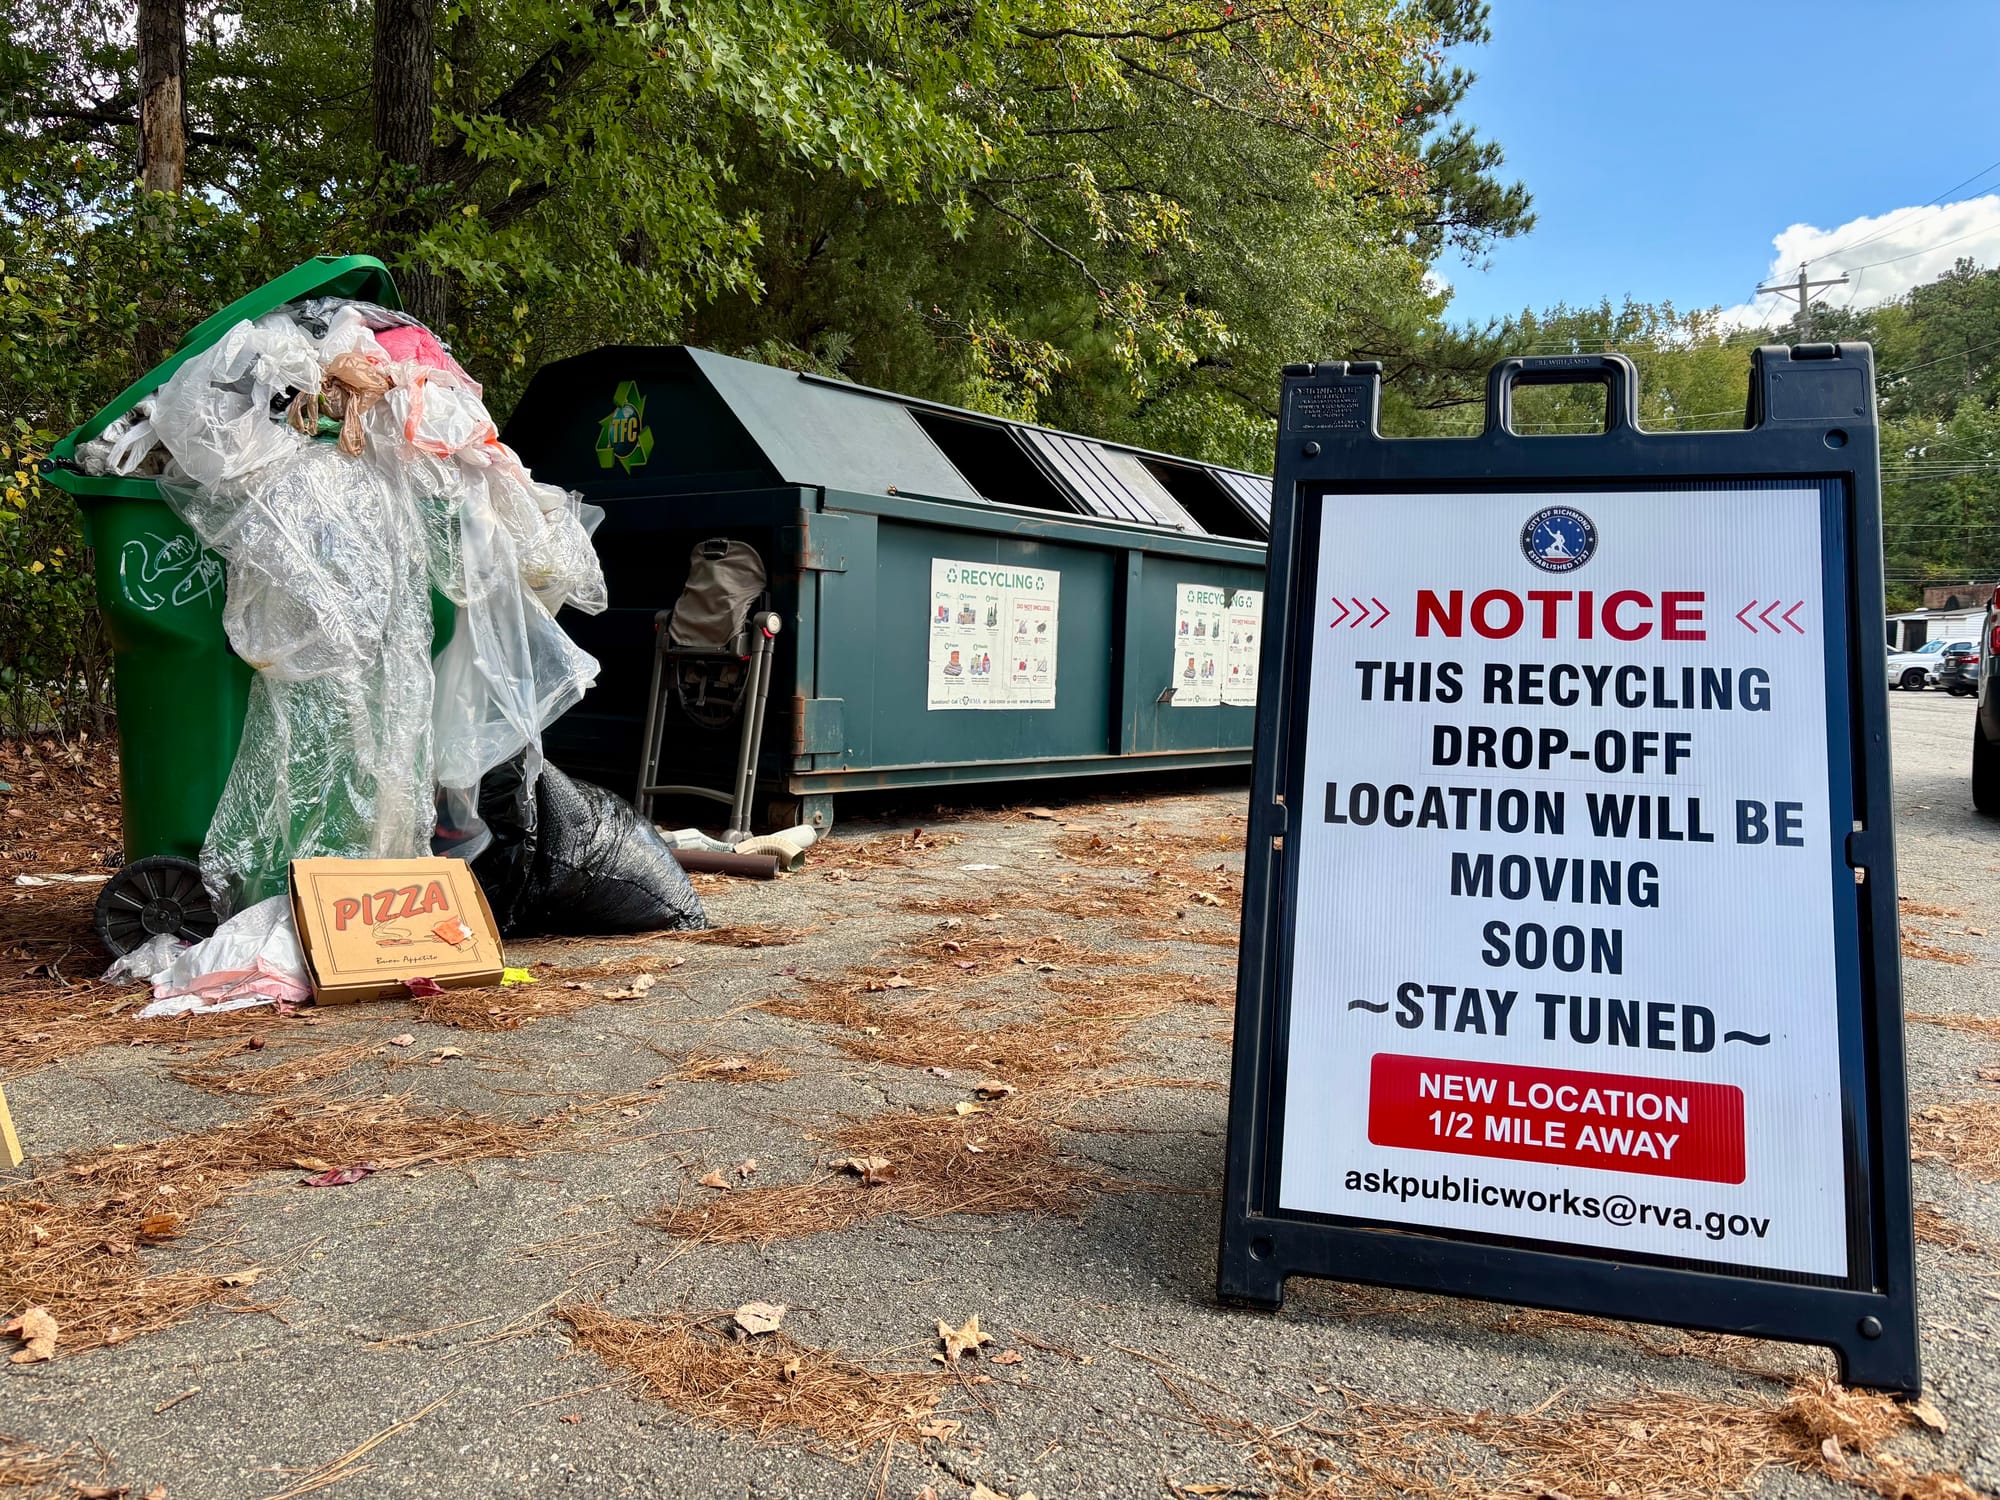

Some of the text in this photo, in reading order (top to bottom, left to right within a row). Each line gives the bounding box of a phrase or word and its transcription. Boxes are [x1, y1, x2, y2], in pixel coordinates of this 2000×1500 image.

[612, 417, 638, 443] TFC
[1527, 509, 1591, 531] CITY OF RICHMOND
[961, 569, 1033, 590] RECYCLING
[1528, 550, 1589, 570] ESTABLISHED 1737
[1196, 591, 1245, 608] RECYCNG
[1415, 589, 1707, 642] NOTICE
[1355, 661, 1771, 711] THIS RECYCLING
[1432, 725, 1692, 775] DROP-OFF
[1324, 782, 1805, 847] LOCATION WILL BE
[1450, 852, 1660, 908] MOVING
[333, 881, 449, 932] PIZZA
[1481, 920, 1624, 975] SOON
[1419, 1072, 1689, 1124] NEW LOCATION
[1429, 1110, 1680, 1160] 1/2 MILE AWAY
[1344, 1168, 1771, 1241] askpublicworks@rva.gov
